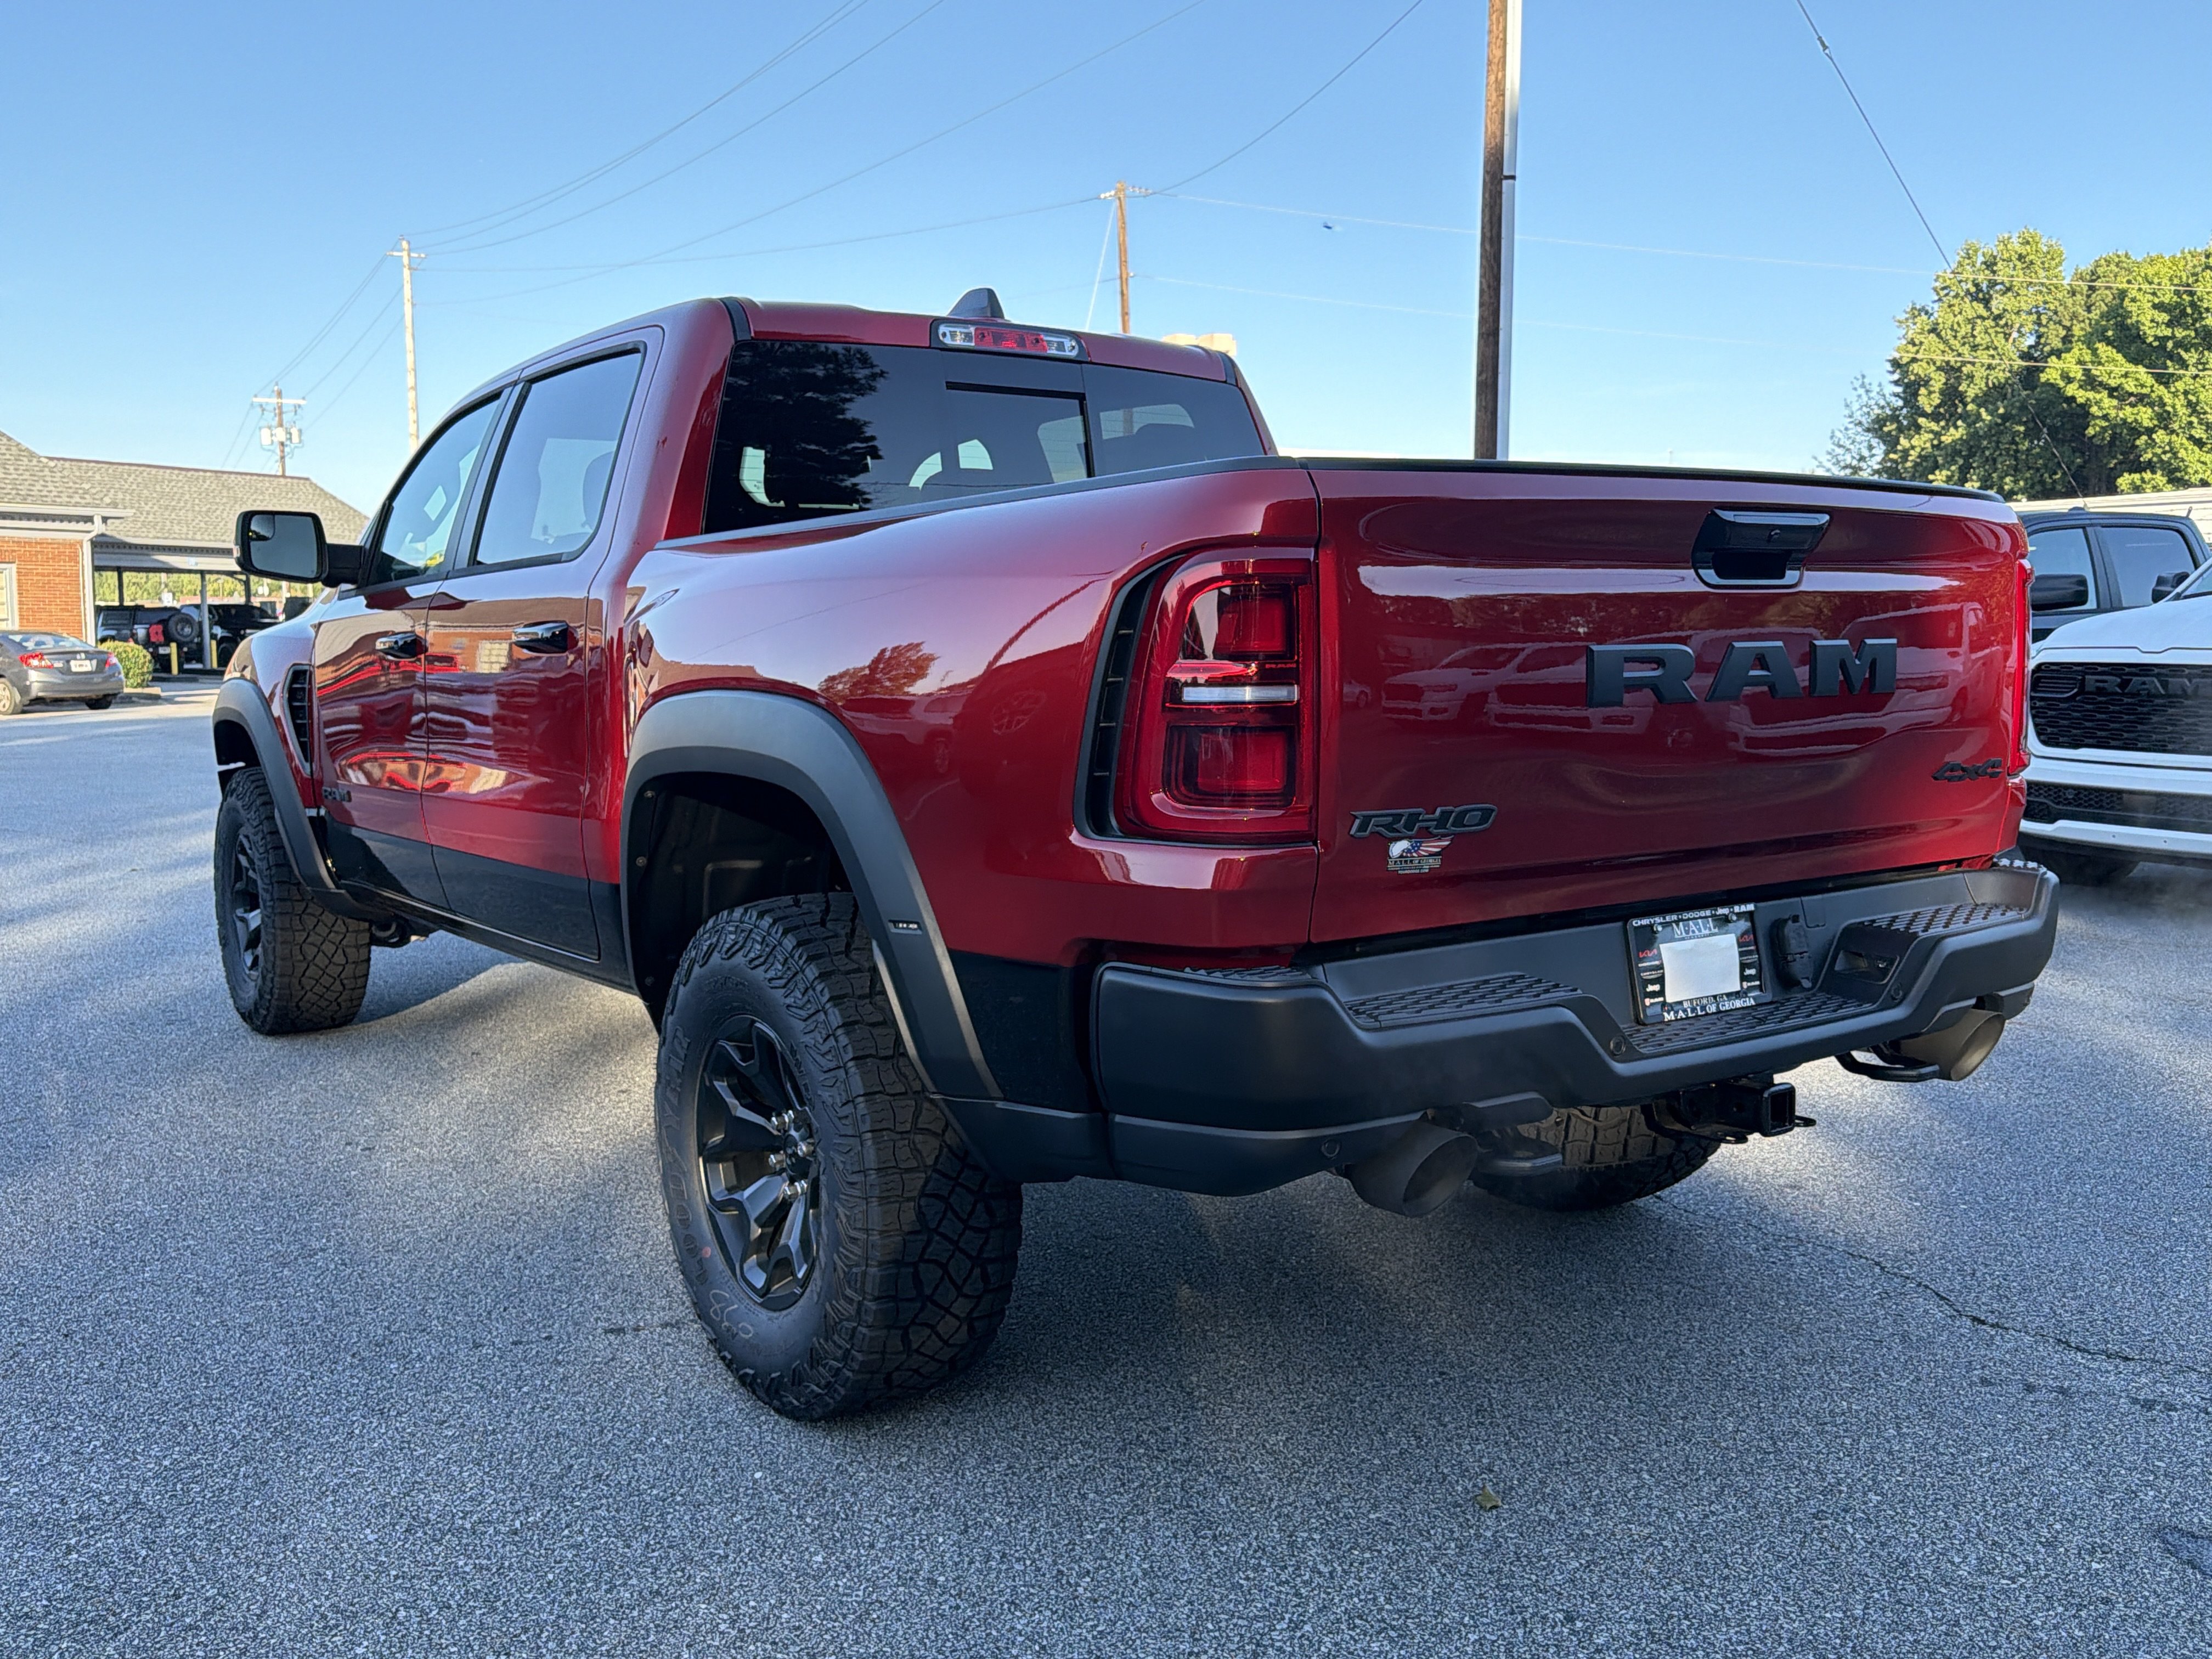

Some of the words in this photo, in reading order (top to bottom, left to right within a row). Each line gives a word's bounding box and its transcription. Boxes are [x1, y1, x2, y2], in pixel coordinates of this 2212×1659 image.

[1586, 637, 1898, 708] RAM
[2085, 674, 2212, 697] RAM
[321, 786, 352, 803] RAM
[1349, 803, 1498, 838] RHO
[1632, 915, 1678, 927] CHRYSLER
[1682, 910, 1711, 919] DODGE
[1716, 906, 1730, 915] Jeep
[1734, 904, 1754, 913] RAM
[1706, 1003, 1717, 1014] OF
[1719, 996, 1755, 1011] GEORGIA
[1717, 994, 1728, 1003] GA
